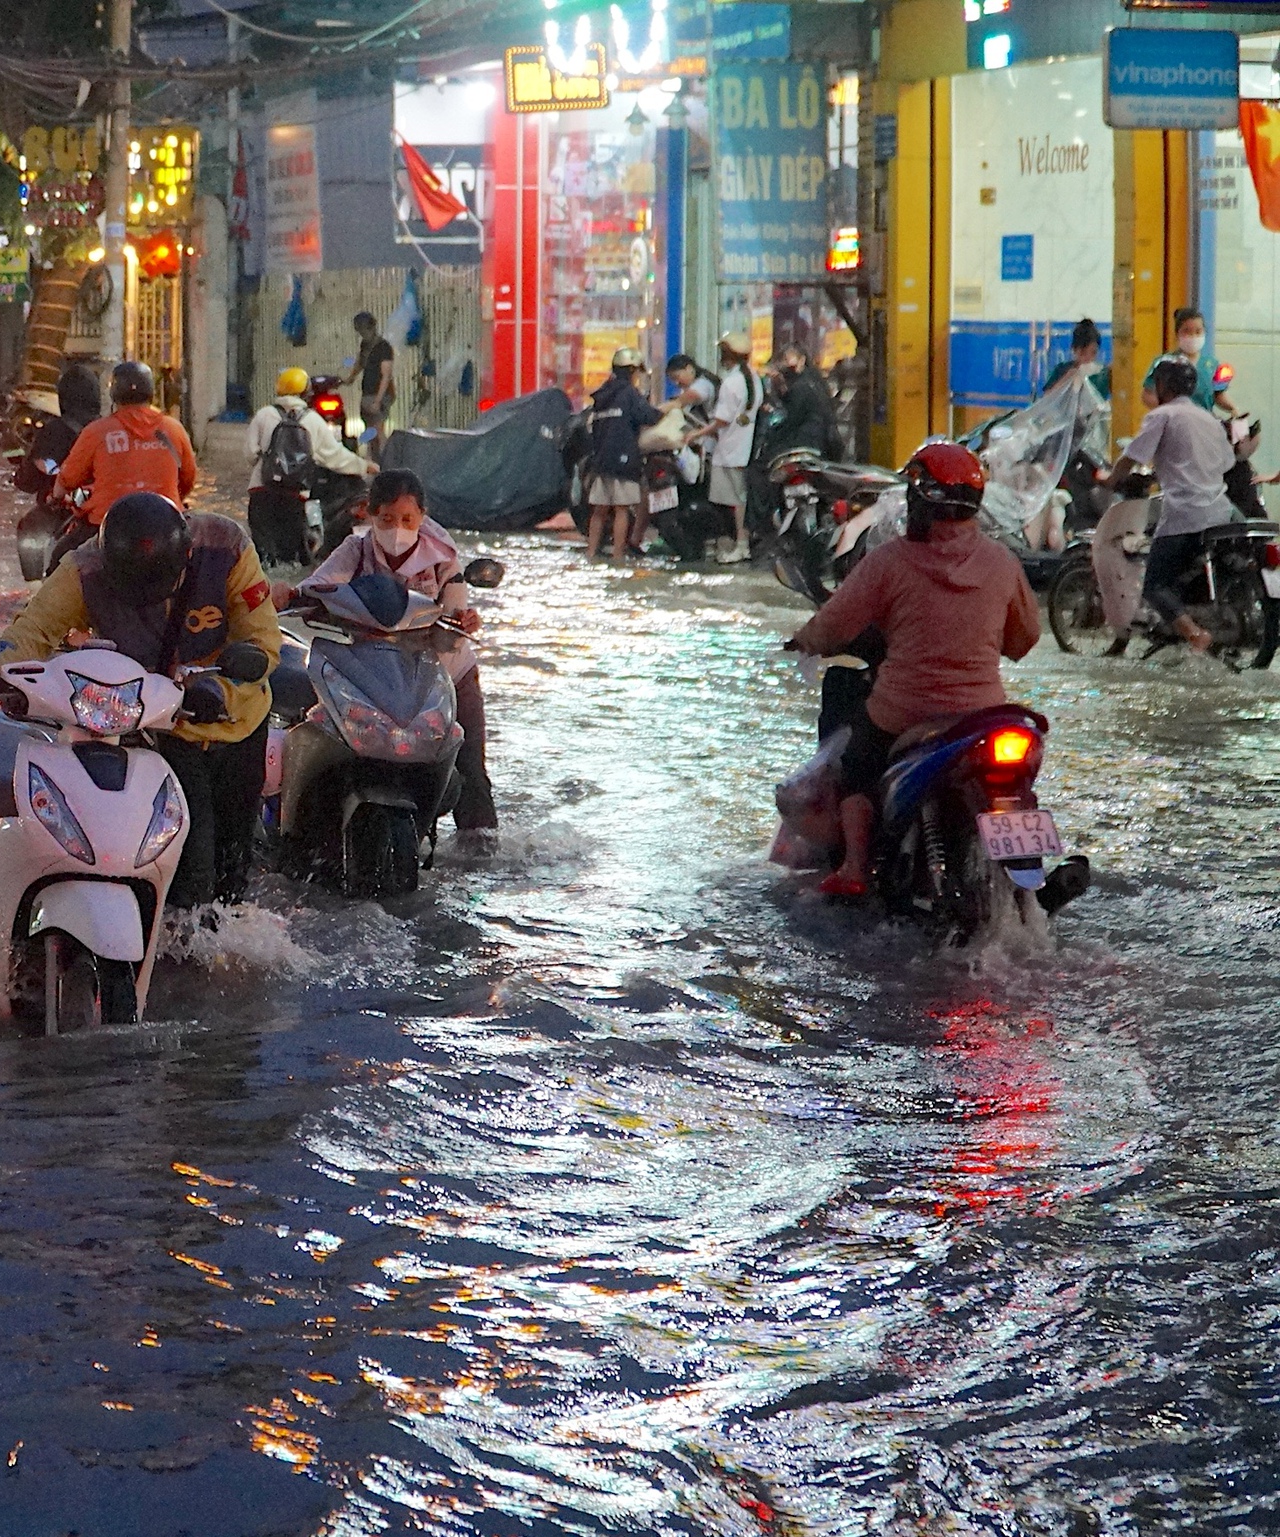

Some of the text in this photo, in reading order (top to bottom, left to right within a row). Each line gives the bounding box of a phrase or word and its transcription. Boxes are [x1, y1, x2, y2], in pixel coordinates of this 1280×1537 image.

[722, 64, 821, 129] BA LÔ
[721, 145, 826, 201] GIÀY DÉP
[1018, 133, 1089, 176] Welcome
